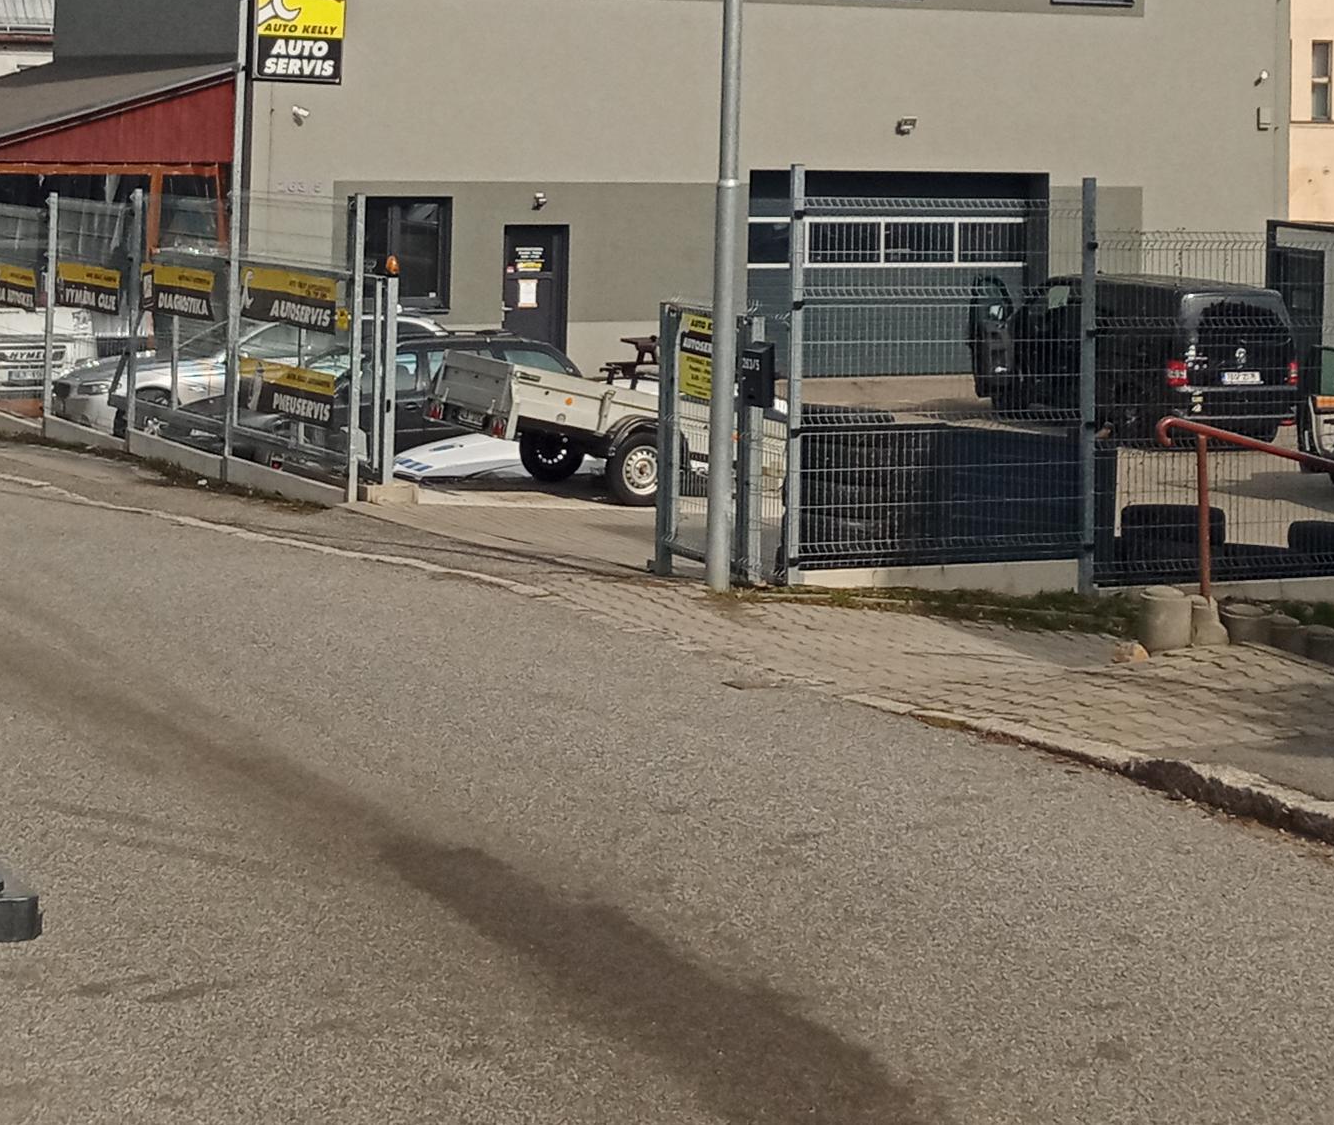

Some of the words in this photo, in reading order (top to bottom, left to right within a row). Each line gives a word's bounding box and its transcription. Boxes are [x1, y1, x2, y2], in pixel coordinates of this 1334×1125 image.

[264, 23, 298, 33] AUTO
[302, 24, 338, 35] KELLY
[271, 39, 329, 57] AUTO
[264, 58, 335, 76] SERVIS
[269, 299, 331, 327] AUTOSERVIS
[10, 351, 46, 360] HYME
[272, 391, 331, 422] PNEUSERVIS
